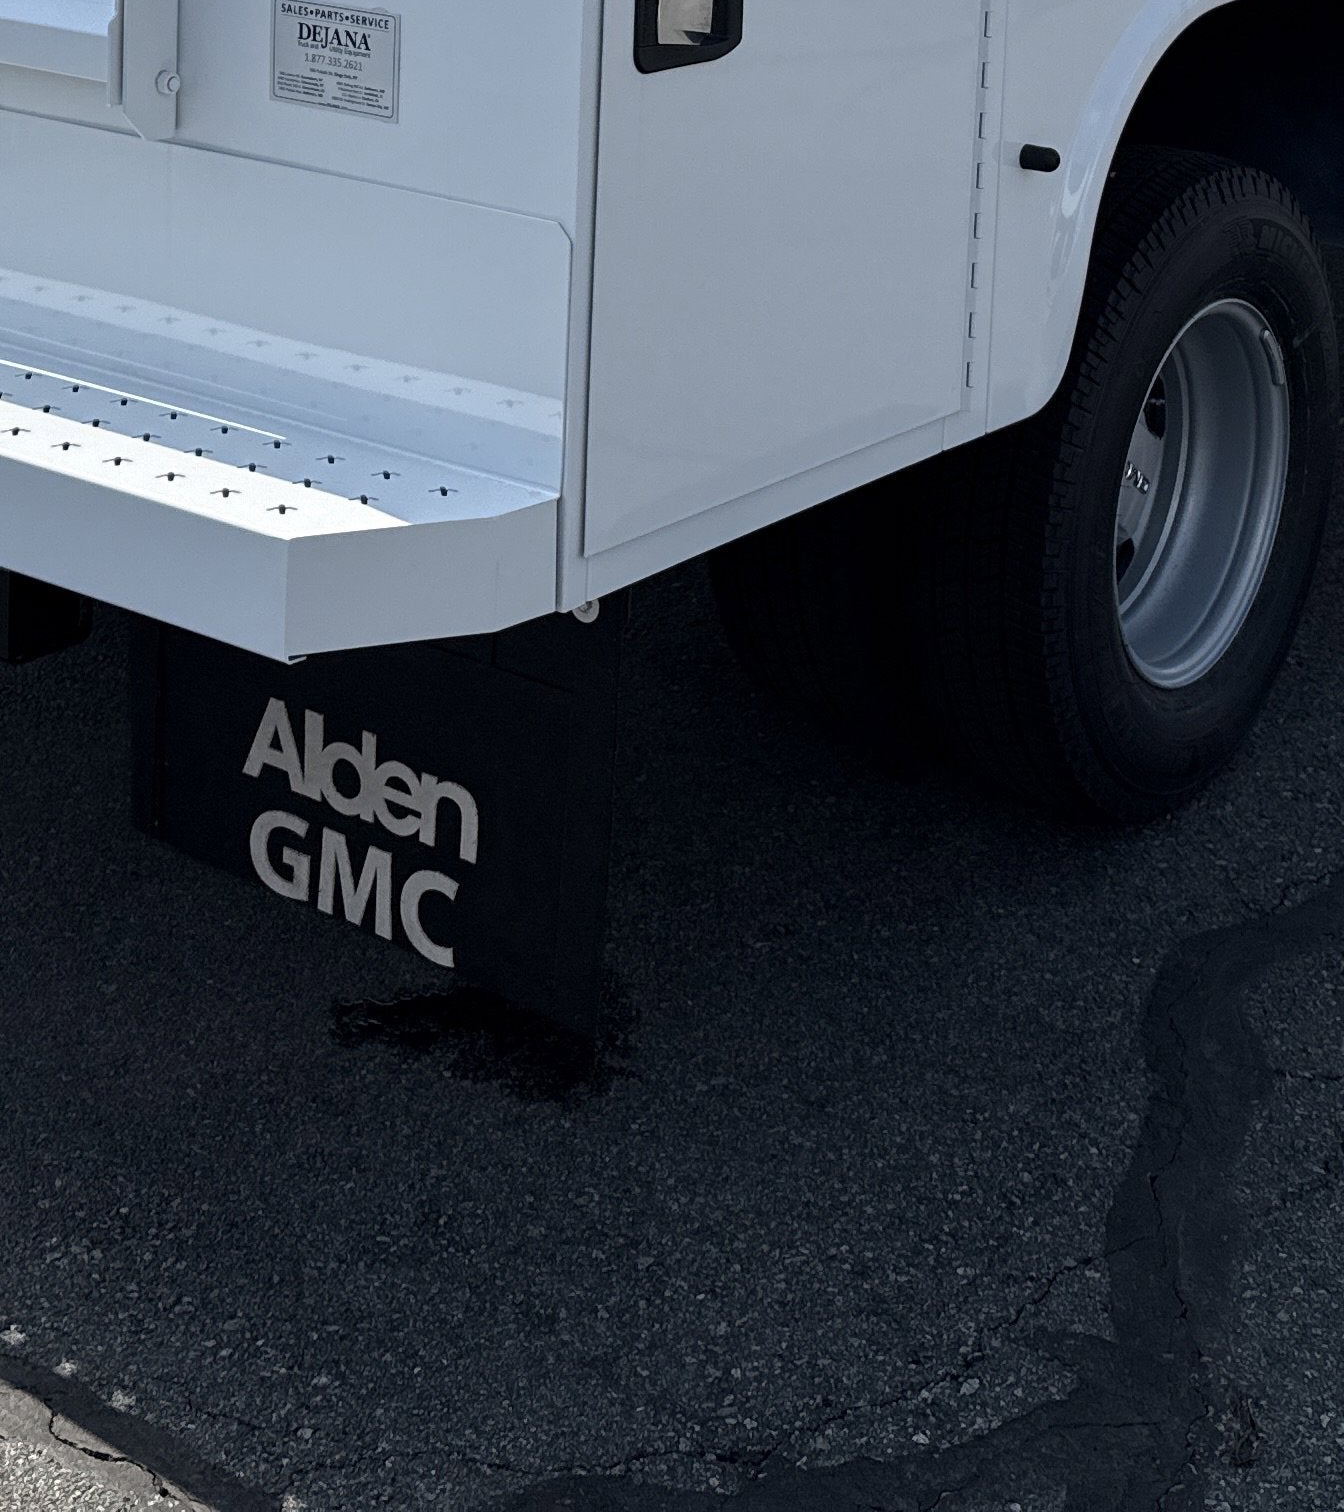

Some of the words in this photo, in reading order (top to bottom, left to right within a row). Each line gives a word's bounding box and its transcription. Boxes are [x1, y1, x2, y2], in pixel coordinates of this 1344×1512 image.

[281, 3, 309, 17] SALES
[314, 9, 344, 22] PARTS
[349, 15, 389, 29] SERVICE
[297, 22, 371, 51] DEJANA
[242, 697, 479, 864] Alden
[250, 810, 459, 968] GMC
